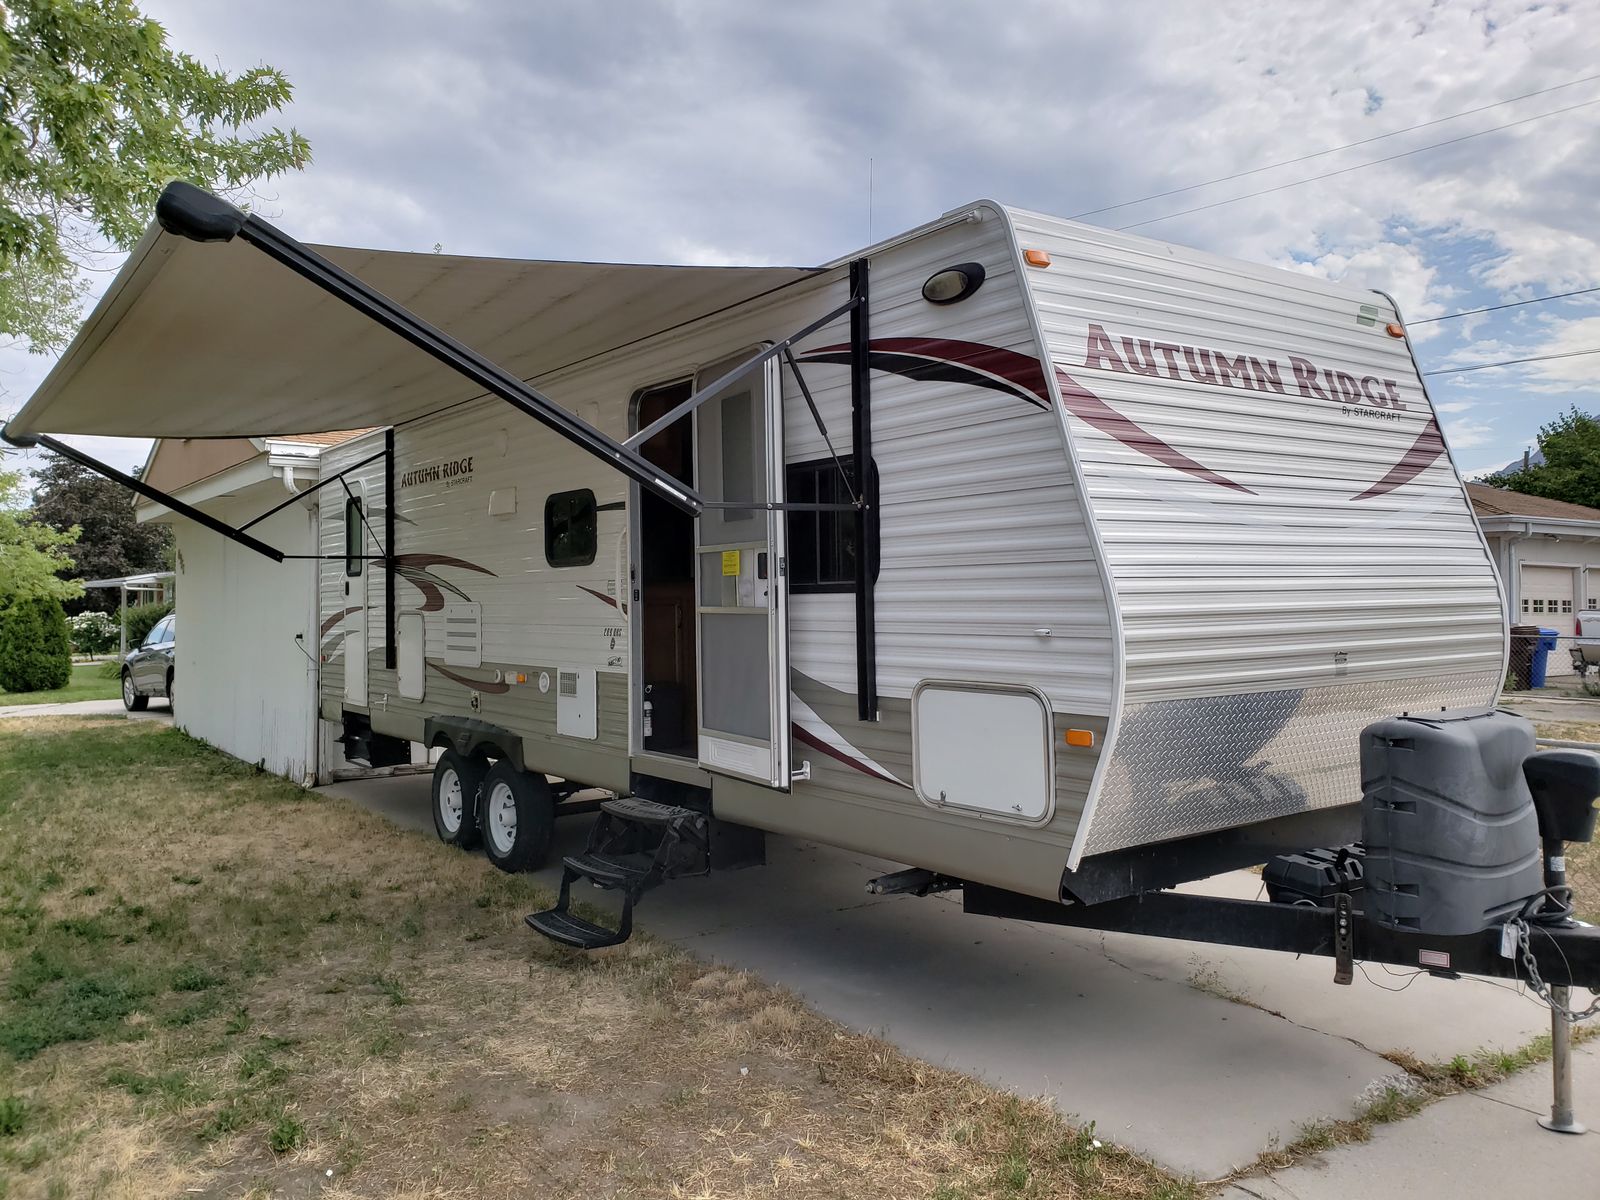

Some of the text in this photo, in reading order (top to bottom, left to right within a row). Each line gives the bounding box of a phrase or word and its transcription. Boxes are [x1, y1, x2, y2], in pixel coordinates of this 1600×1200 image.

[1084, 323, 1408, 411] AUTUMN RIDGE
[1342, 405, 1402, 422] By STARCRAFT
[401, 457, 474, 488] AUTUMN RIDGE
